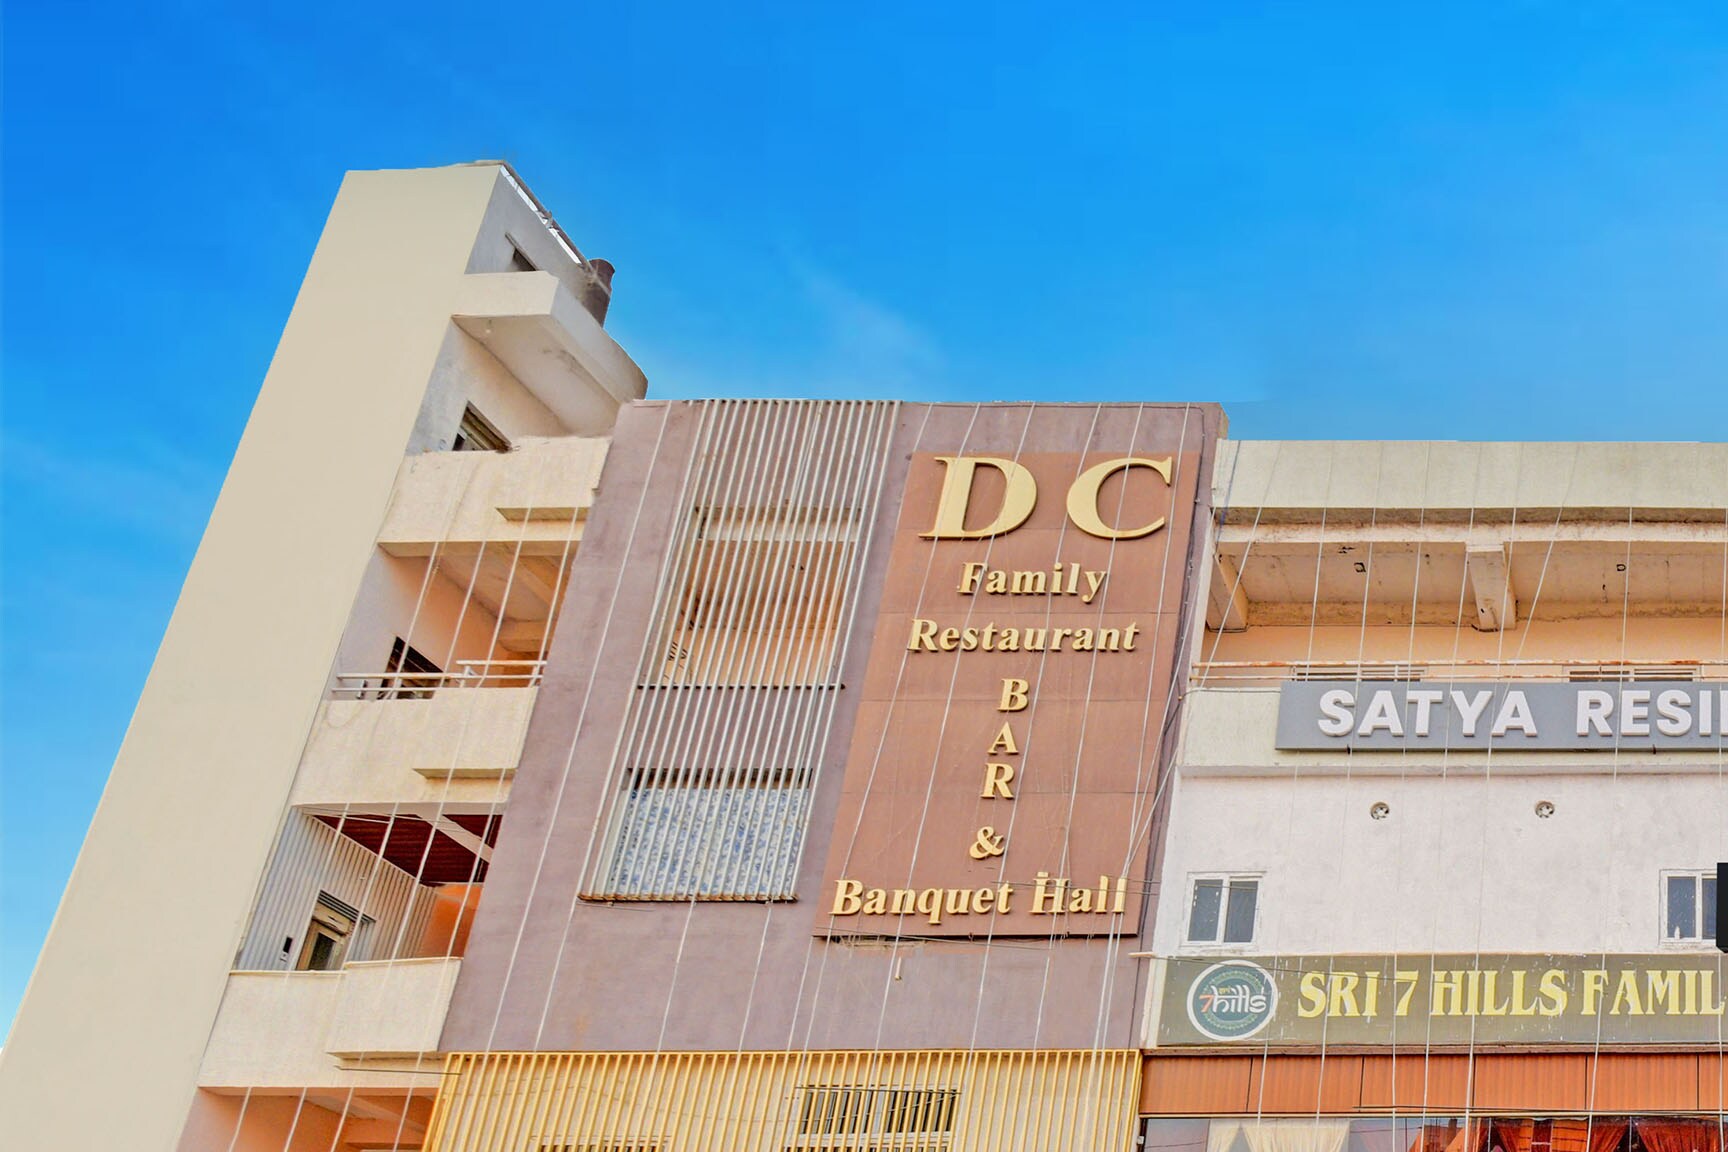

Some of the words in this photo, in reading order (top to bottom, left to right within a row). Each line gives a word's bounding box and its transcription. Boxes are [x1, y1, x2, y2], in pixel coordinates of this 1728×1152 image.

[956, 562, 1108, 604] Family
[906, 618, 1141, 653] Restaurant
[1317, 689, 1539, 739] SATYA
[968, 825, 1006, 860] &
[828, 878, 1014, 925] Banquet
[1028, 873, 1128, 915] Hall
[1297, 969, 1379, 1019] SRI
[1393, 969, 1418, 1017] 7
[1430, 968, 1568, 1018] HILLS
